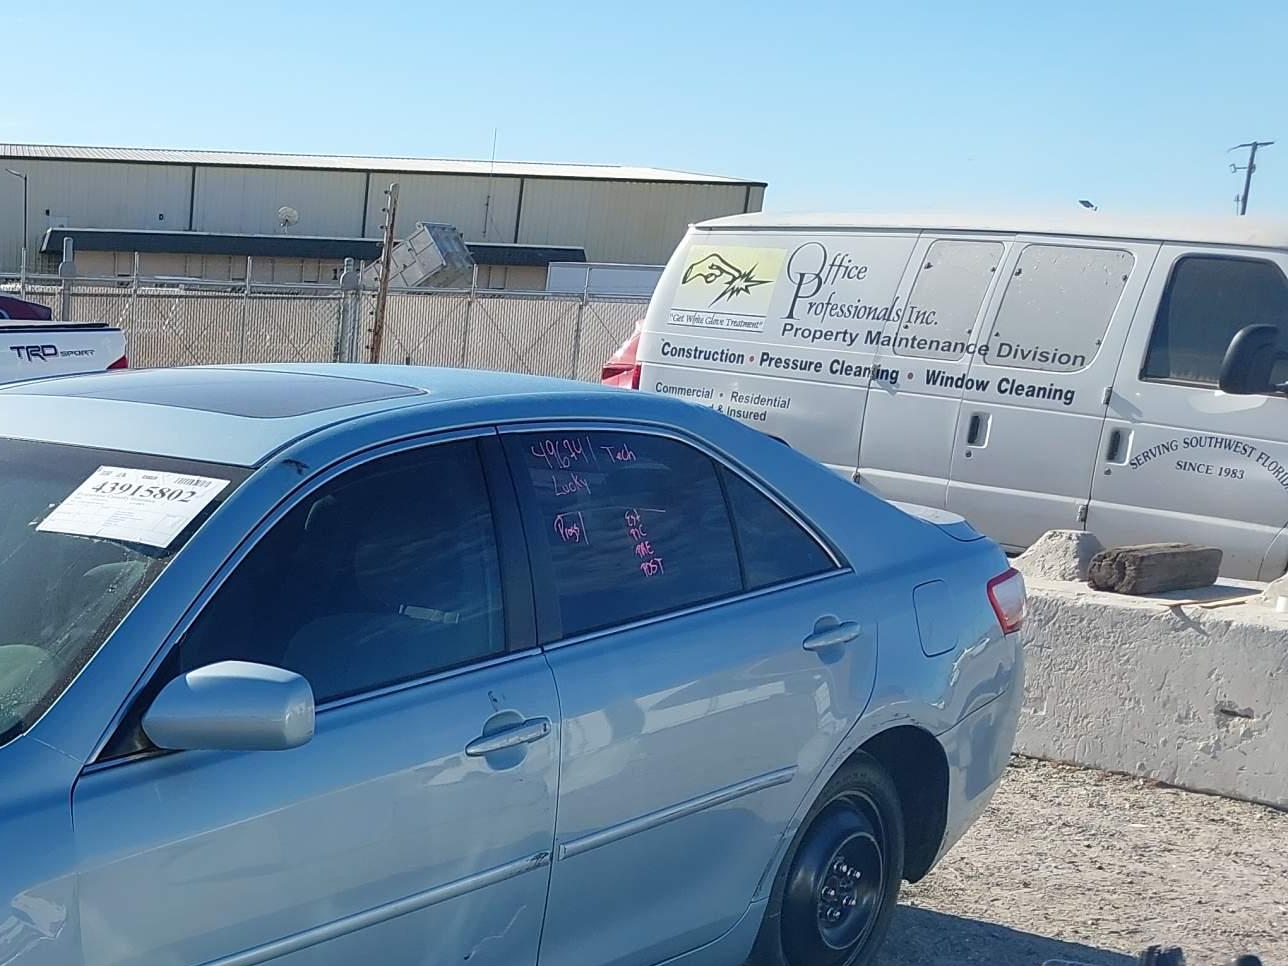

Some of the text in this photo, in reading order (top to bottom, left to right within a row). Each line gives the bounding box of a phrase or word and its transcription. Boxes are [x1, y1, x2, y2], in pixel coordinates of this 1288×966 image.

[787, 241, 868, 286] Office
[779, 271, 939, 325] Professionals Inc.
[9, 344, 95, 362] TRD SPORT
[781, 322, 1086, 367] Property Maintenance Division
[660, 341, 1076, 405] Construction Pressure Cleaning Window Cleaning
[655, 382, 791, 409] Commercial Residential
[727, 406, 767, 421] Insured
[600, 443, 637, 464] Tech
[1129, 439, 1179, 470] SERVING
[1183, 436, 1257, 458] SOUTHWEST
[1175, 460, 1245, 480] SINCE 1983
[91, 480, 198, 503] 43915802
[552, 472, 591, 496] Lucky
